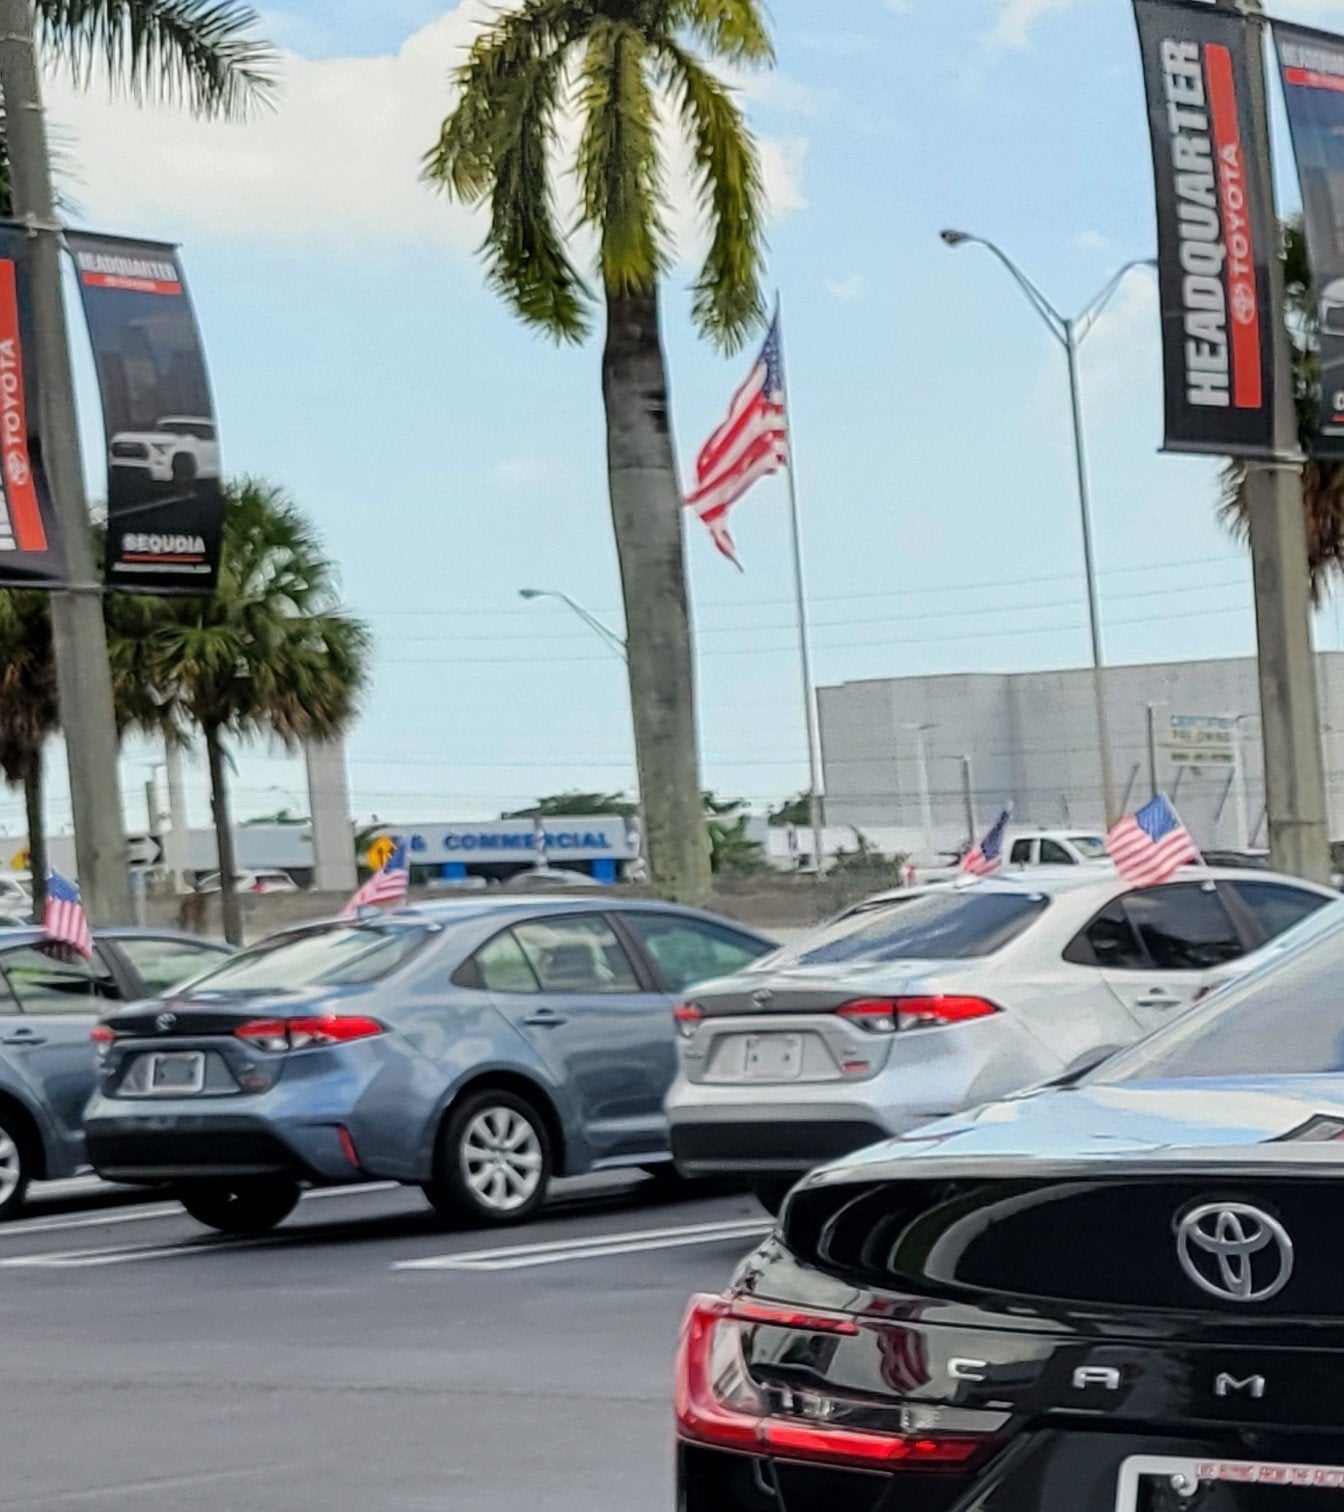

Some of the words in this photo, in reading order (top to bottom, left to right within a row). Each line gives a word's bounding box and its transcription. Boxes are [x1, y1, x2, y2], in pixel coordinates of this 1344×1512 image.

[1160, 37, 1231, 408] HEADQUARTER
[1219, 143, 1251, 278] TOYOTA
[123, 532, 206, 553] SEQUOIA
